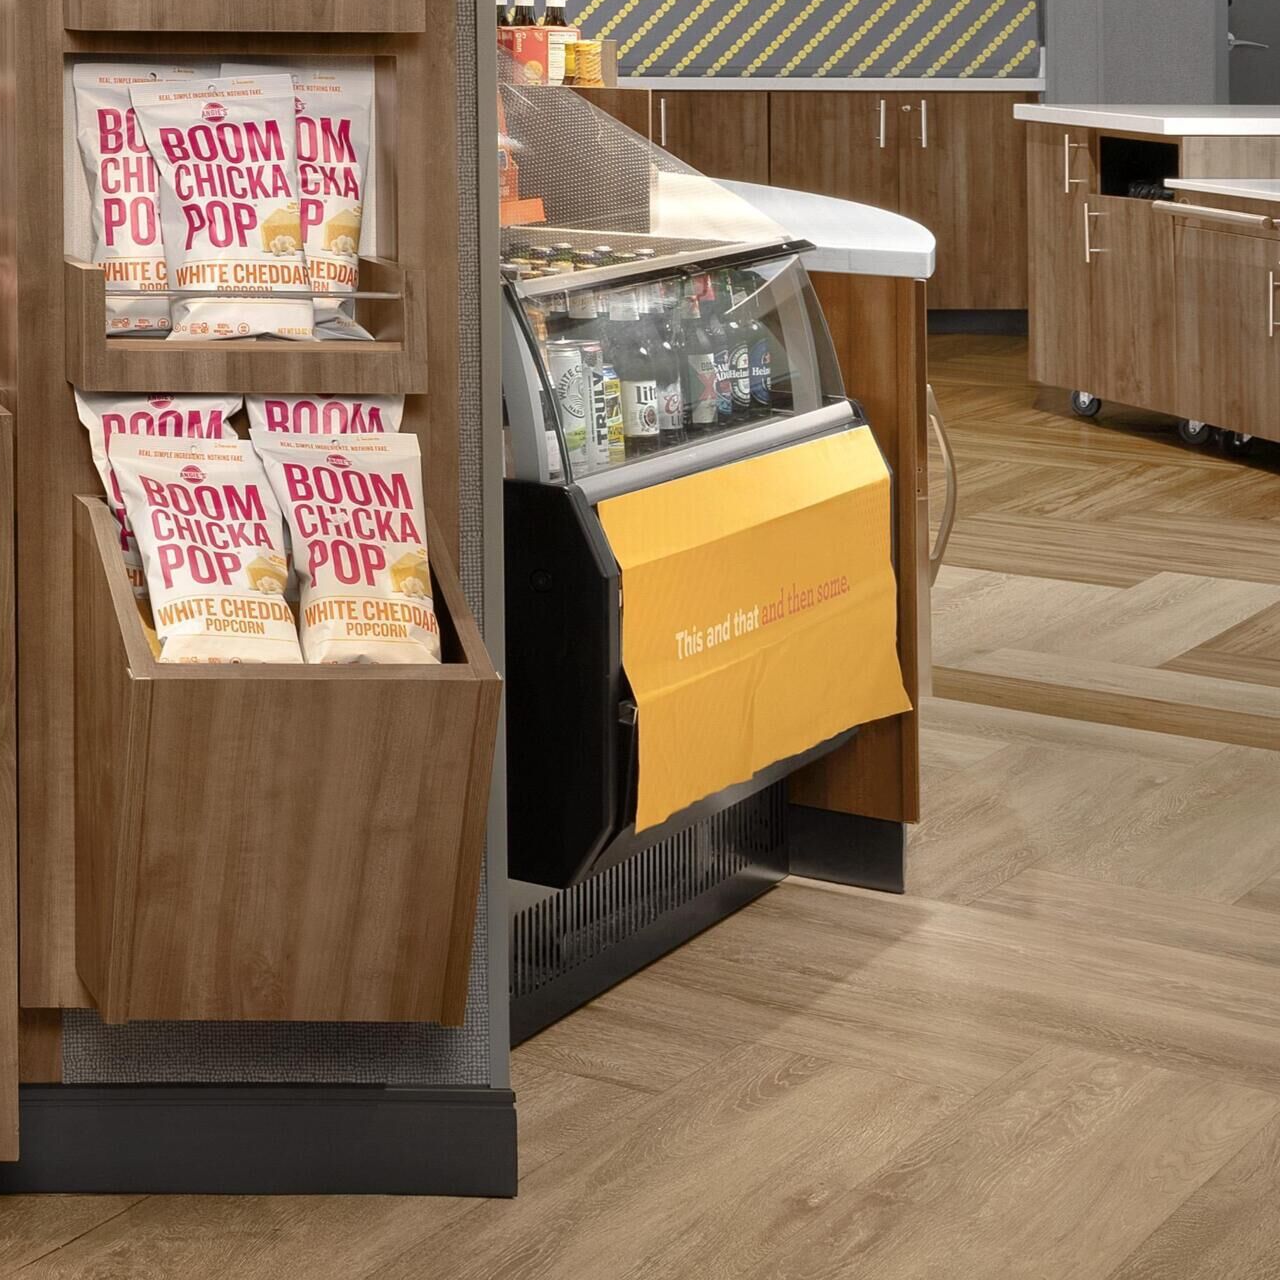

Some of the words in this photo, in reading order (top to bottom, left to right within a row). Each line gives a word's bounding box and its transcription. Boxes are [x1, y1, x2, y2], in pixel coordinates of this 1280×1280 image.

[159, 121, 285, 165] BOOM
[175, 164, 291, 201] CHICKA
[182, 200, 258, 250] POP
[98, 261, 151, 282] WHITE
[176, 263, 228, 287] WHITE
[234, 263, 309, 285] CHEDDAR
[140, 475, 267, 521] BOOM
[283, 463, 414, 510] BOOM
[153, 508, 275, 550] CHICKA
[293, 504, 422, 545] CHICKA
[158, 544, 241, 589] POP
[310, 540, 386, 588] POP
[158, 598, 216, 627] WHITE
[206, 618, 265, 635] POPCORN
[304, 600, 357, 628] WHITE
[362, 601, 439, 634] CHEDDAR
[346, 623, 408, 638] POPCORN
[675, 625, 703, 660] This
[706, 620, 730, 648] and
[733, 604, 760, 635] that
[761, 594, 784, 626] and
[787, 583, 814, 615] then
[817, 574, 850, 604] some.
